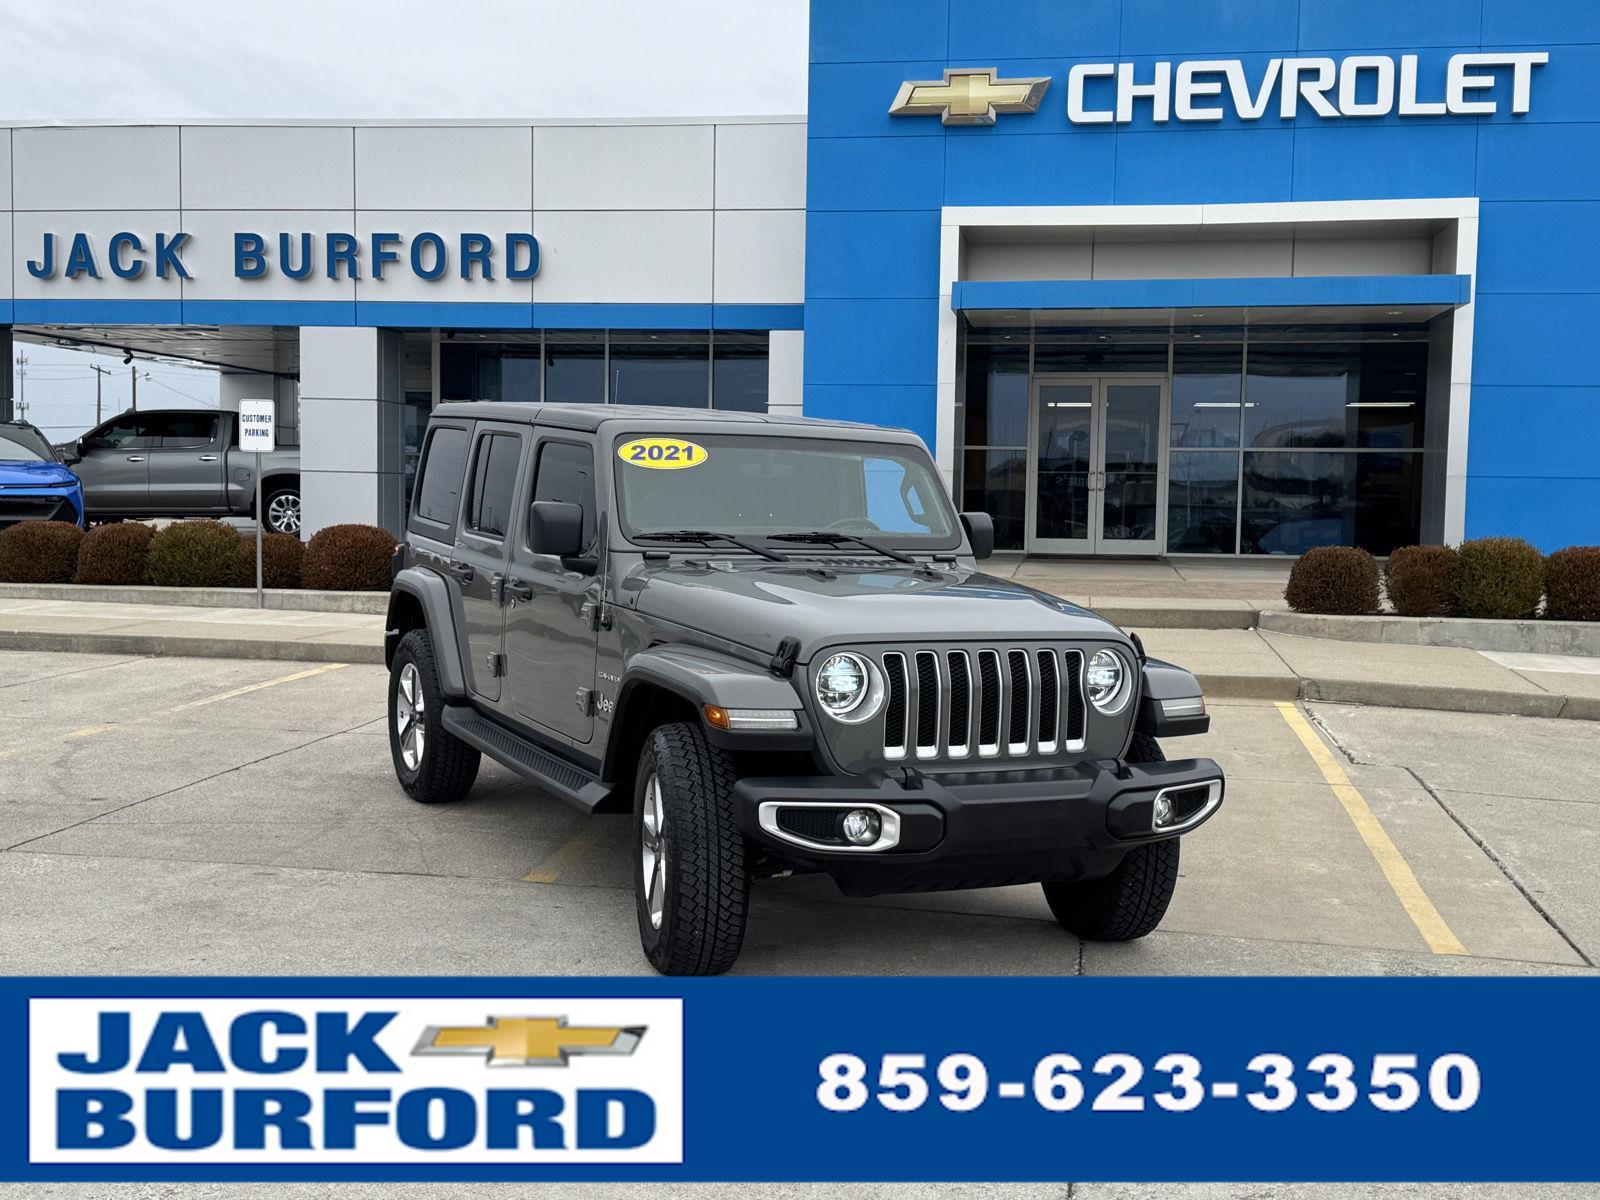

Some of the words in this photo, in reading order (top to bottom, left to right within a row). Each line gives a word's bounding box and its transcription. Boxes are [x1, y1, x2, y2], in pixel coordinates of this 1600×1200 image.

[1067, 51, 1549, 124] CHEVROLET
[27, 231, 192, 280] JACK
[234, 232, 541, 281] BURFORD
[241, 414, 272, 423] CUSTOMER
[244, 428, 270, 437] PARKING
[630, 444, 694, 461] 2021
[596, 693, 614, 713] Jee
